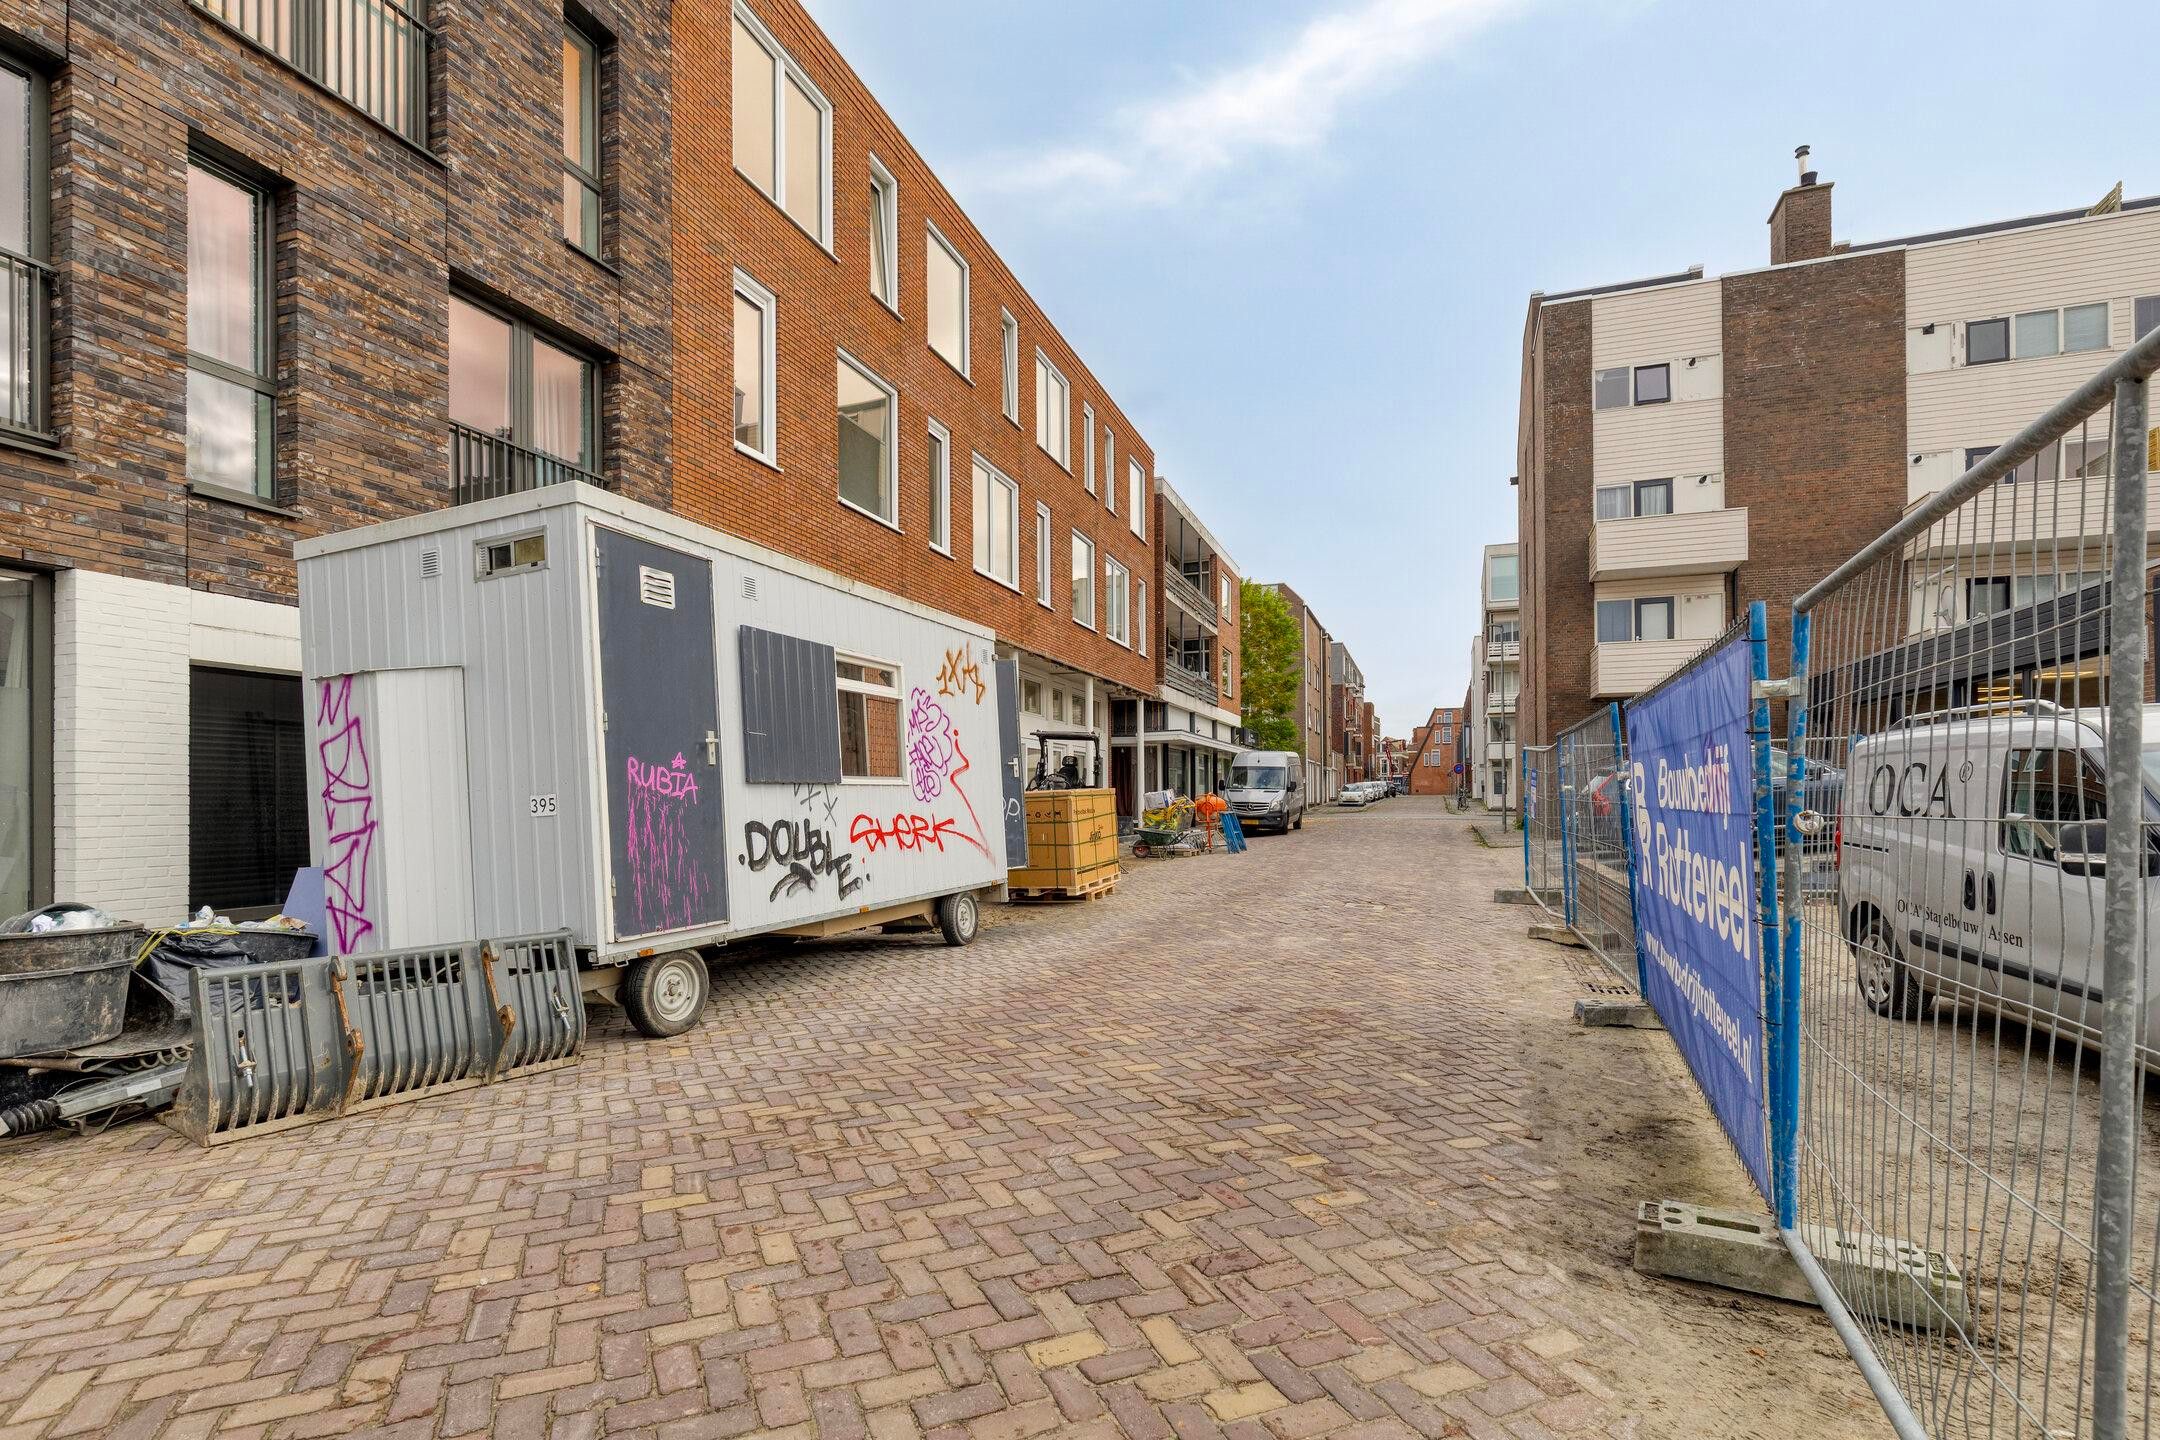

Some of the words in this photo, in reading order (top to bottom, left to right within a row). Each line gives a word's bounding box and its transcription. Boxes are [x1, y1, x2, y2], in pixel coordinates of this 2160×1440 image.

[531, 797, 556, 814] 395
[627, 756, 699, 805] RUBIA
[1657, 744, 1731, 831] Bouwbedrijf
[1656, 821, 1751, 961] Rotteveel
